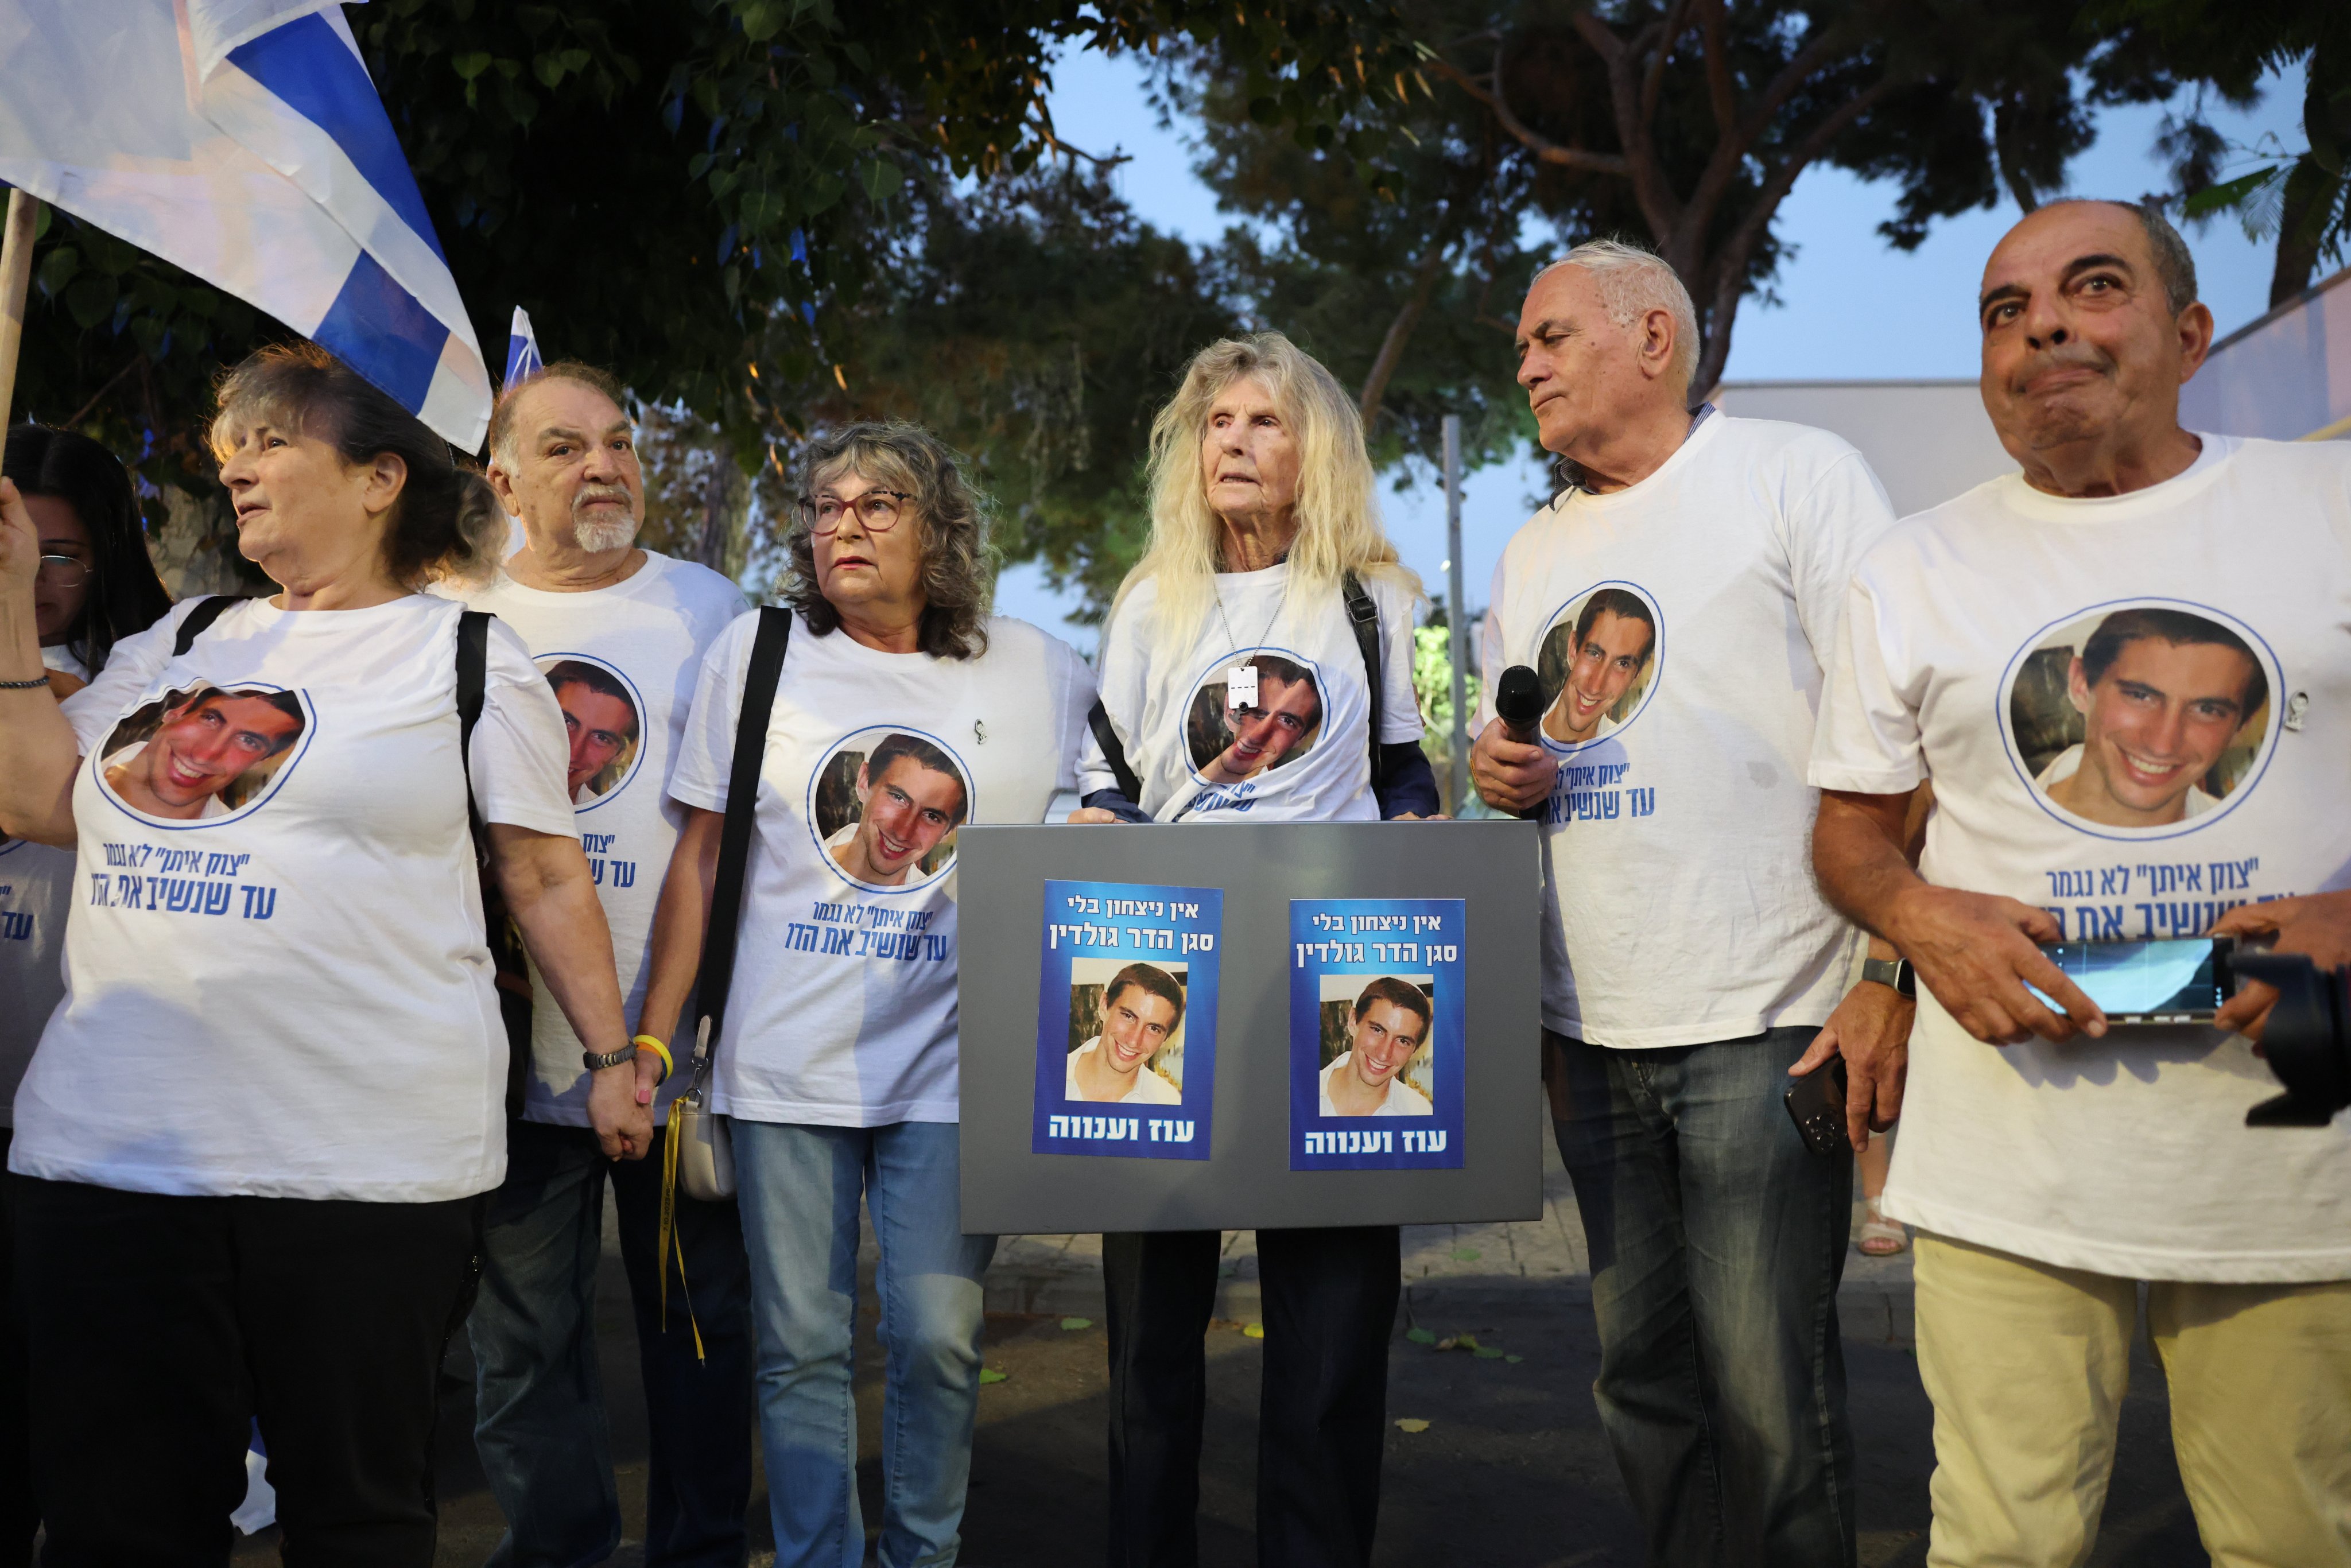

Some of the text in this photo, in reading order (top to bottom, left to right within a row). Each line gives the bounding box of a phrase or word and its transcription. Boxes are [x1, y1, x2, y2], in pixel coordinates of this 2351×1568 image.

[1565, 791, 1619, 822] שנשיב
[1626, 787, 1654, 817] עד
[129, 844, 153, 867] לא
[610, 860, 636, 887] עד
[2046, 857, 2259, 897] "צוק איתן" לא נגמר
[146, 876, 232, 915] שנשיב
[240, 885, 277, 919] עד
[1067, 894, 1198, 922] אין ניצחון בלי
[2, 911, 34, 940] עד
[813, 901, 843, 923] נגמר
[844, 903, 864, 924] לא
[1312, 912, 1441, 935] אין ניצחון בלי
[2076, 904, 2123, 941] את
[2135, 899, 2246, 939] נשיב
[820, 926, 854, 956] את
[855, 929, 921, 961] שנשיב
[924, 934, 946, 961] עד
[1049, 921, 1214, 955] סגן הדר גולדין
[1296, 938, 1457, 968] סגן הדר גולדין
[1049, 1115, 1195, 1143] עוז וענווה
[1305, 1130, 1446, 1154] עוז וענווה
